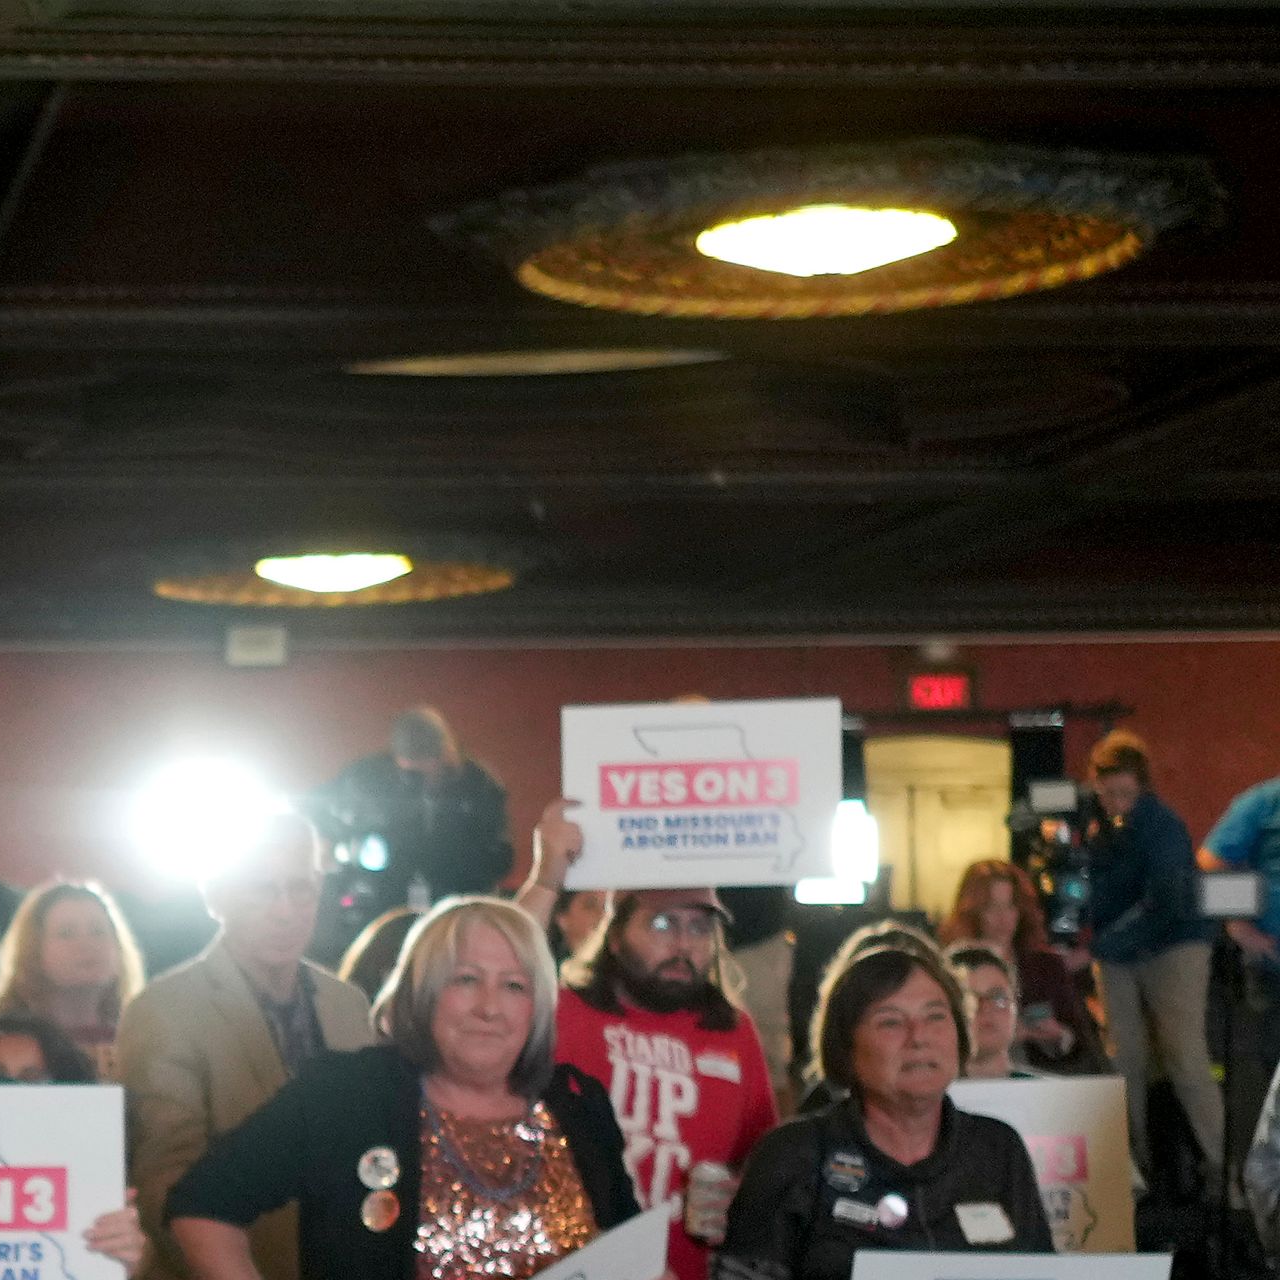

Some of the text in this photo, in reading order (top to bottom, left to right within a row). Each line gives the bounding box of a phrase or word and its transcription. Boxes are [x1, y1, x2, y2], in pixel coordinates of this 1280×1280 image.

[608, 766, 789, 805] YES ON 3
[609, 1058, 700, 1142] UP
[23, 1177, 55, 1225] 3
